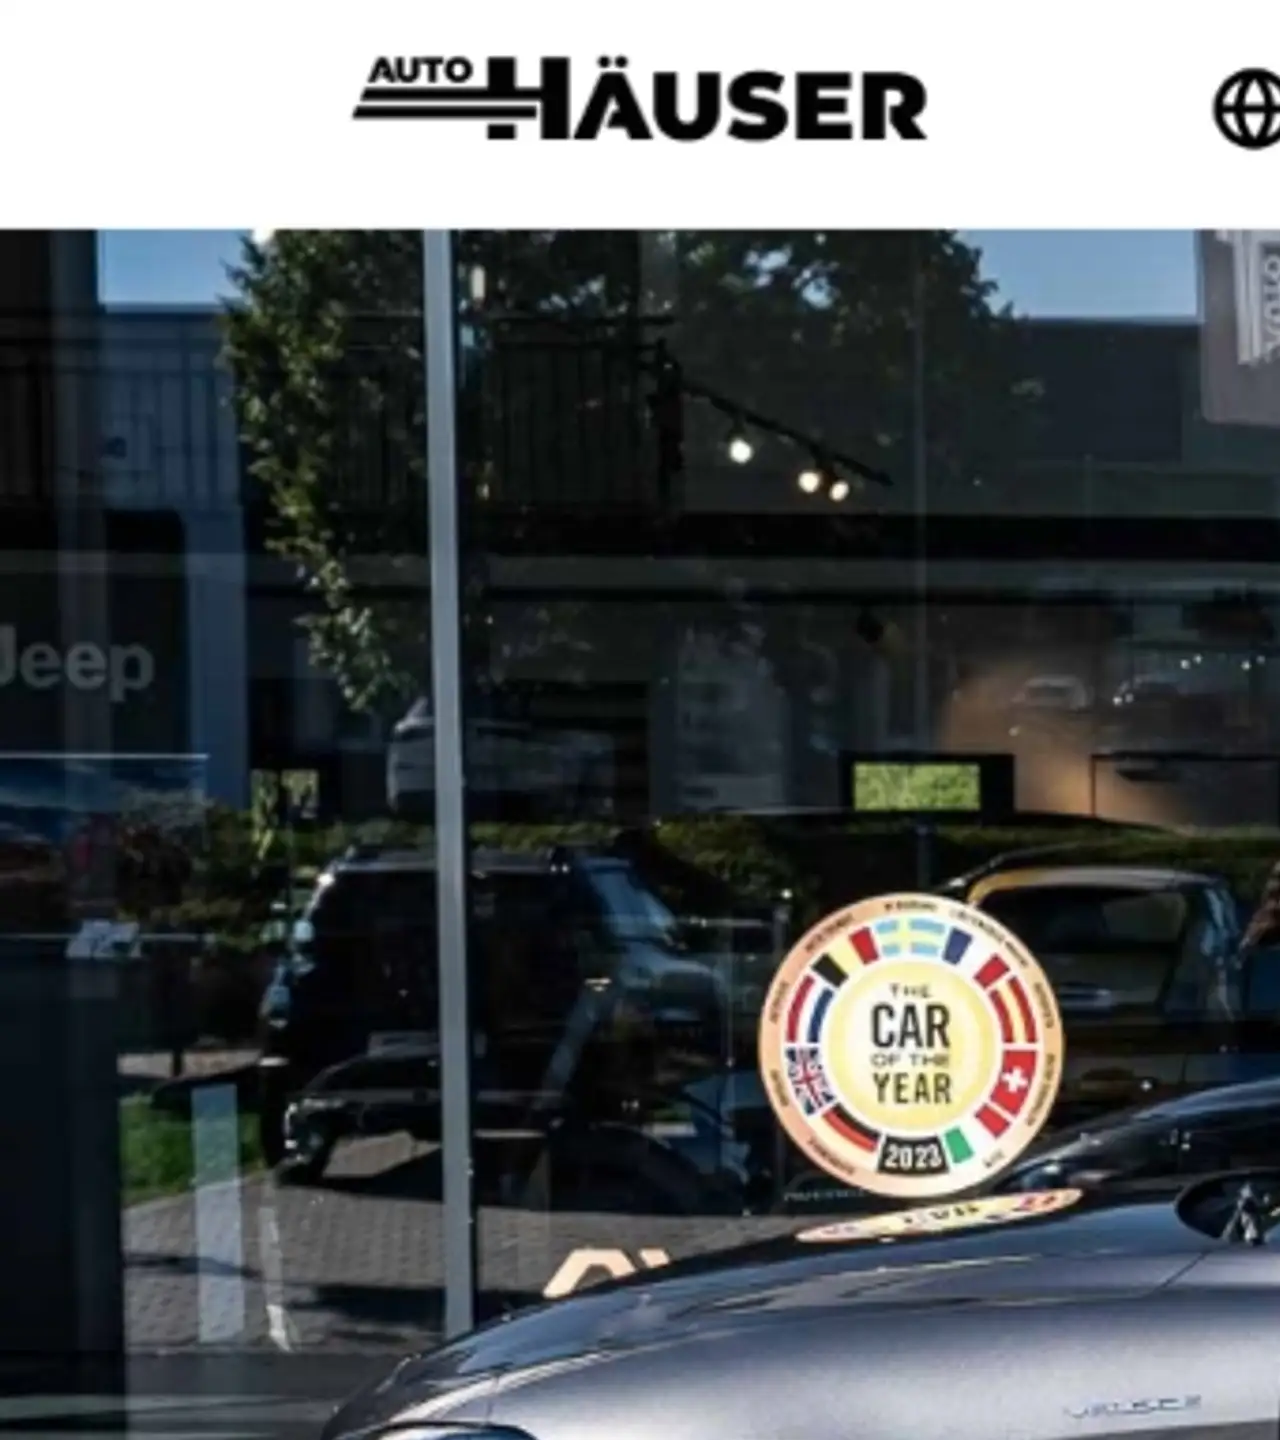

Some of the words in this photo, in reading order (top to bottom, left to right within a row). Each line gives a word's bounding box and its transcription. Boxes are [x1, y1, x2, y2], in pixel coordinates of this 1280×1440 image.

[889, 982, 932, 999] THE
[871, 1001, 951, 1050] CAR
[870, 1052, 901, 1068] OF
[909, 1052, 950, 1068] THE
[872, 1071, 953, 1105] YEAR
[884, 1145, 943, 1170] 2023
